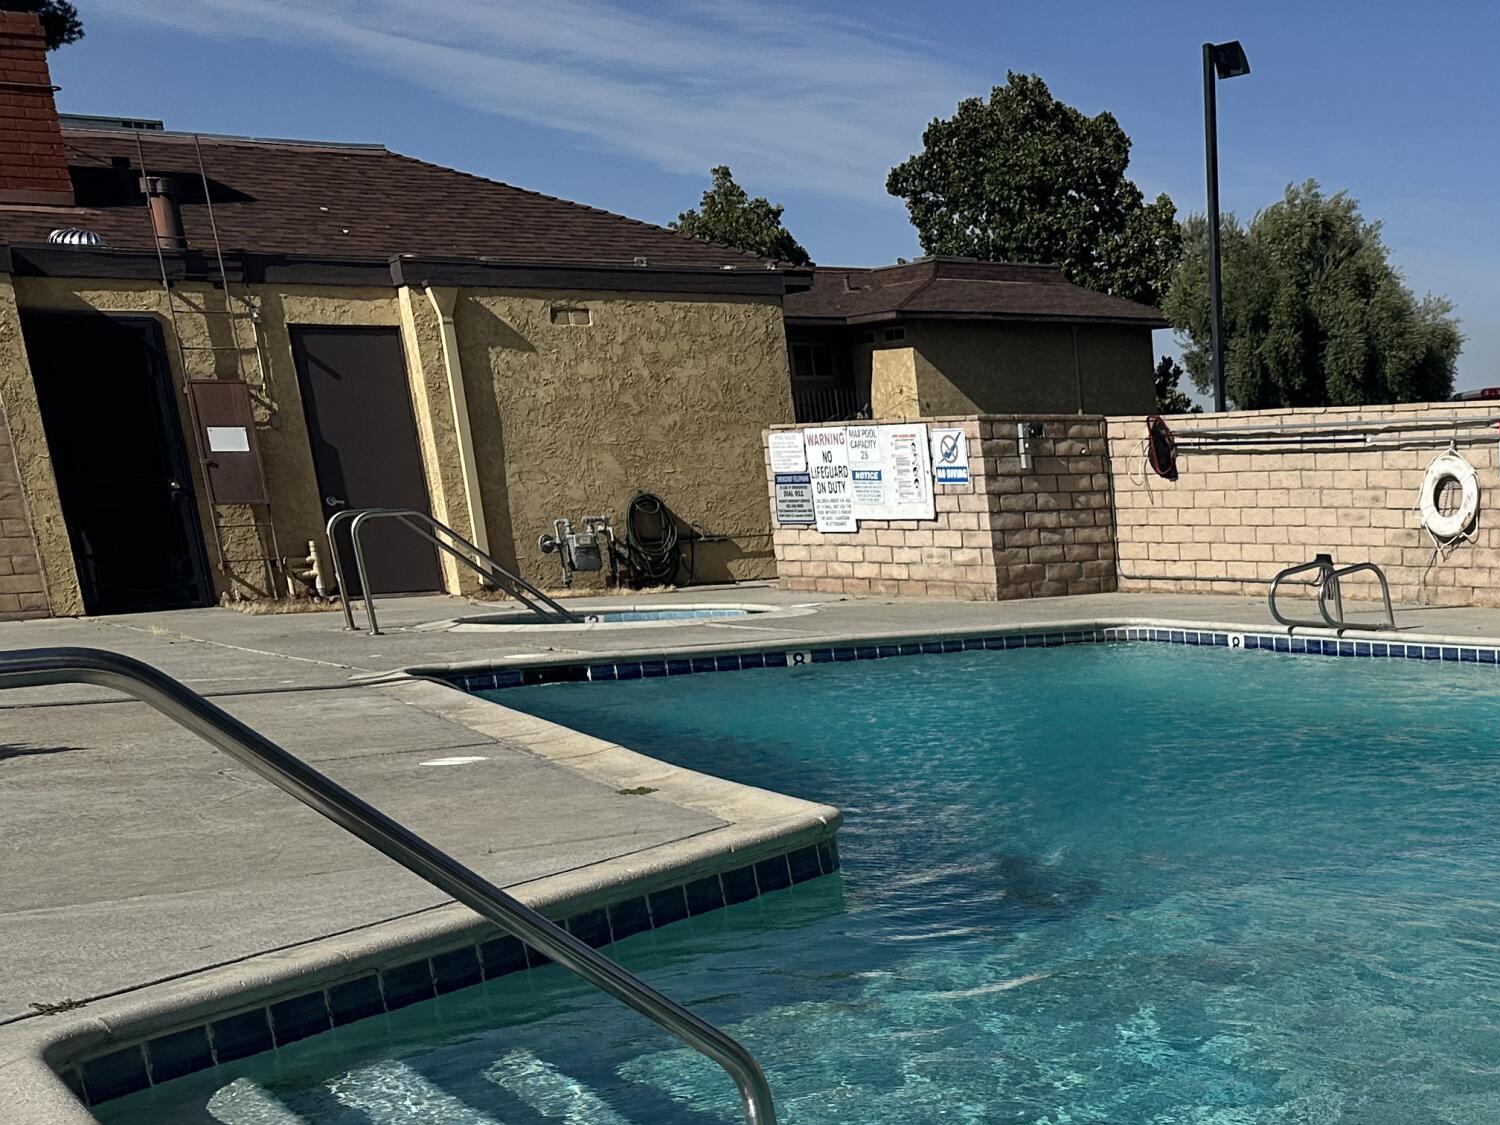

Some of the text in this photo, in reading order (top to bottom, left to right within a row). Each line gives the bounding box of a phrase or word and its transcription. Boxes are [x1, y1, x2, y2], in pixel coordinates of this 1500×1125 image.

[849, 428, 877, 438] MAX POOL
[806, 432, 845, 446] WARNING
[850, 439, 877, 449] CAPACITY
[822, 450, 833, 463] NO
[860, 451, 869, 460] 25
[811, 465, 849, 479] LIFEGUARD
[855, 471, 879, 480] NOTICE
[937, 468, 968, 479] NO DIVING
[816, 480, 846, 494] ON DUTY
